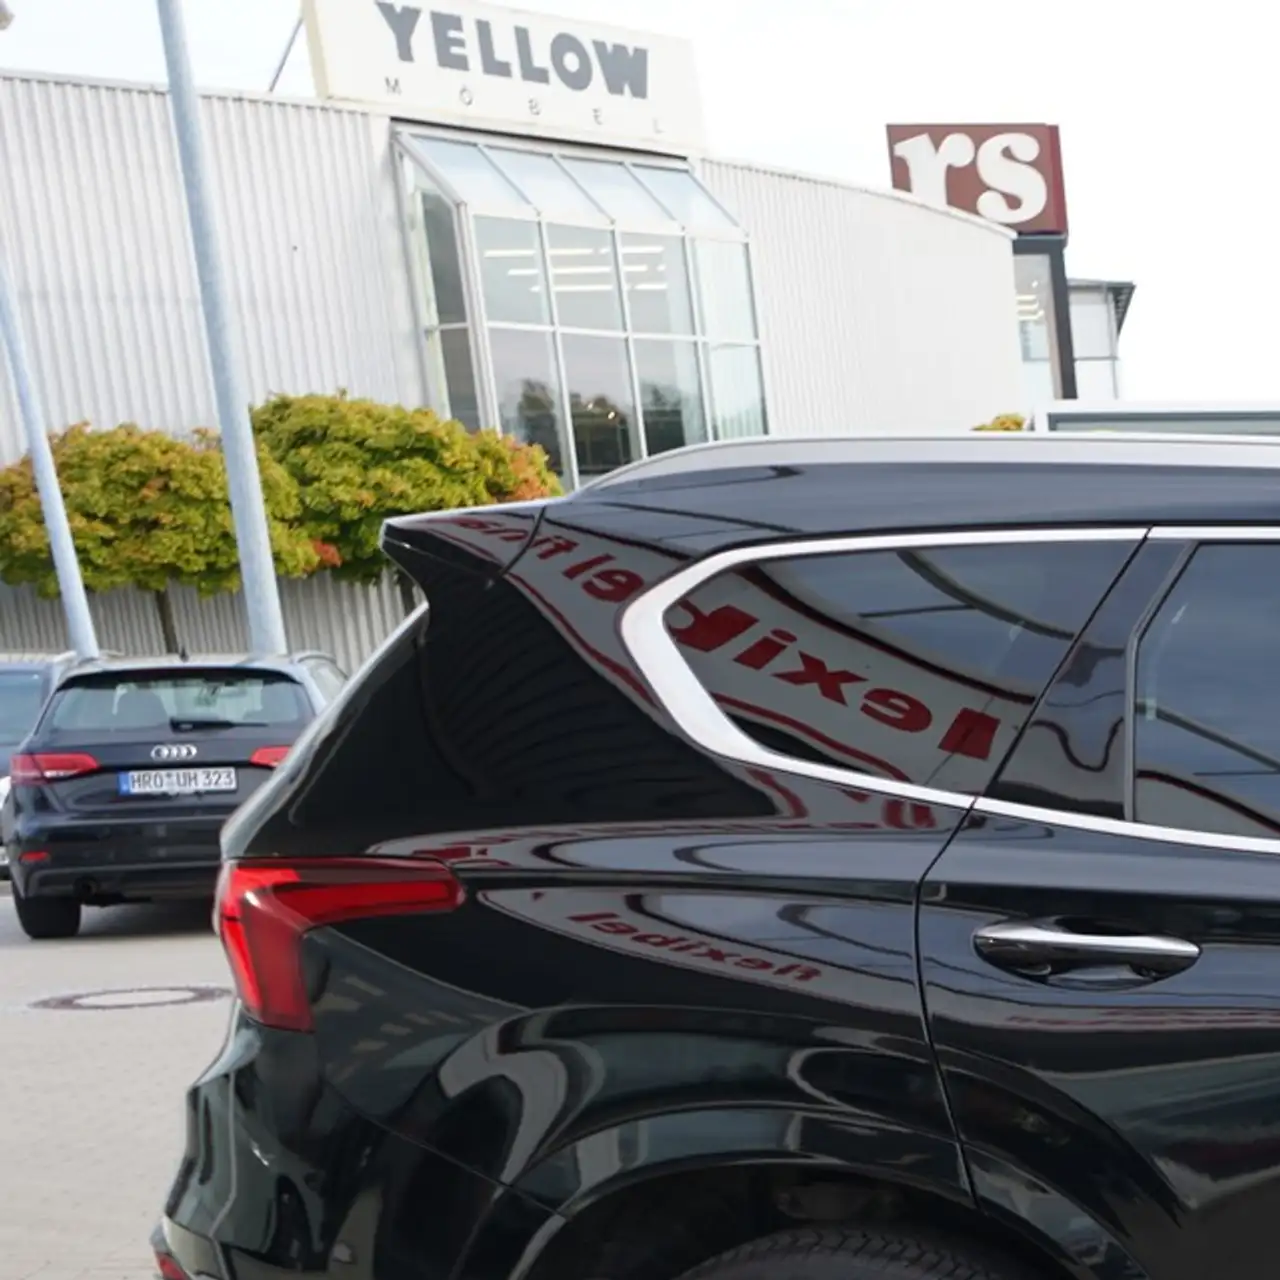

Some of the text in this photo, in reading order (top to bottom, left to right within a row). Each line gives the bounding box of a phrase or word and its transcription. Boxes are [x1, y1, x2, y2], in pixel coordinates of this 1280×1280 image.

[374, 0, 649, 100] YELLOW
[893, 132, 1048, 224] rs
[131, 768, 233, 788] HRO UH 323
